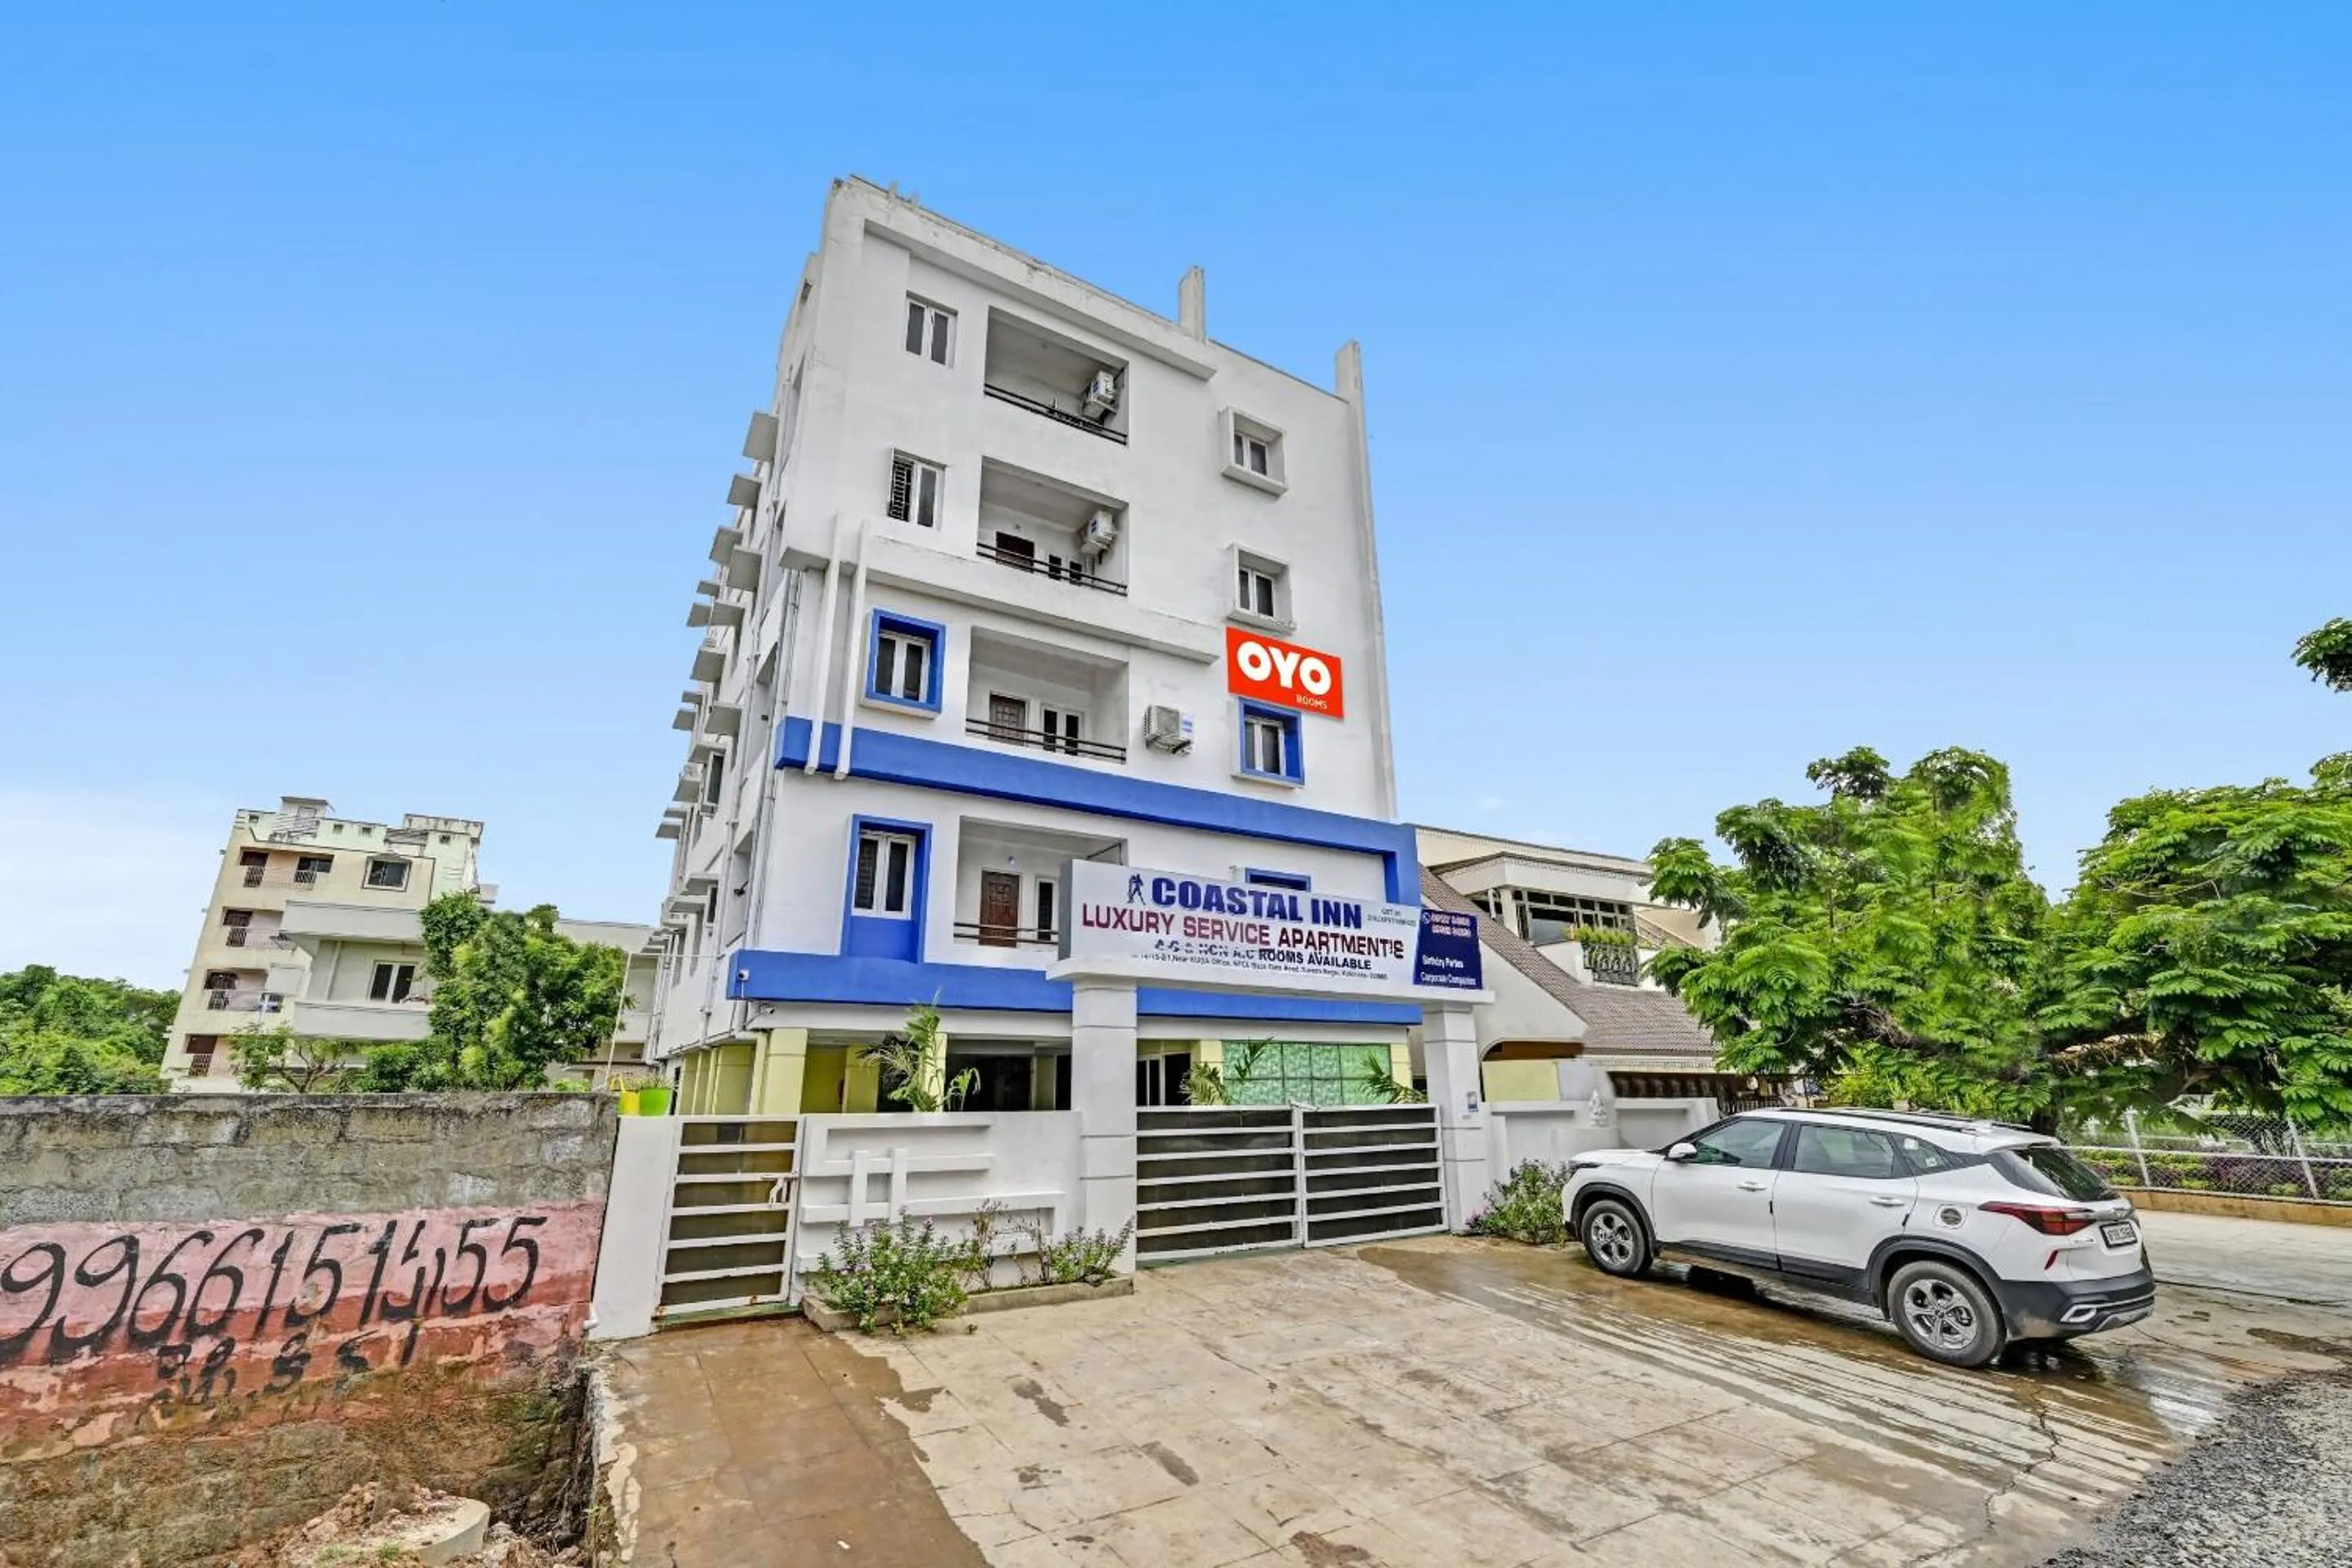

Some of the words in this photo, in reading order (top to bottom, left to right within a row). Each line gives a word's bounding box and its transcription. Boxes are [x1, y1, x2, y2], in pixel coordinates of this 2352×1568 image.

[1237, 641, 1331, 695] OYO
[1296, 694, 1328, 710] ROOMS
[1083, 903, 1174, 935] LUXURY
[1183, 915, 1270, 946] SERVICE
[1152, 877, 1303, 923] COASTAL
[1311, 899, 1361, 929] INN
[1258, 948, 1303, 964] ROOMS
[1307, 952, 1371, 970] AVAILABLE
